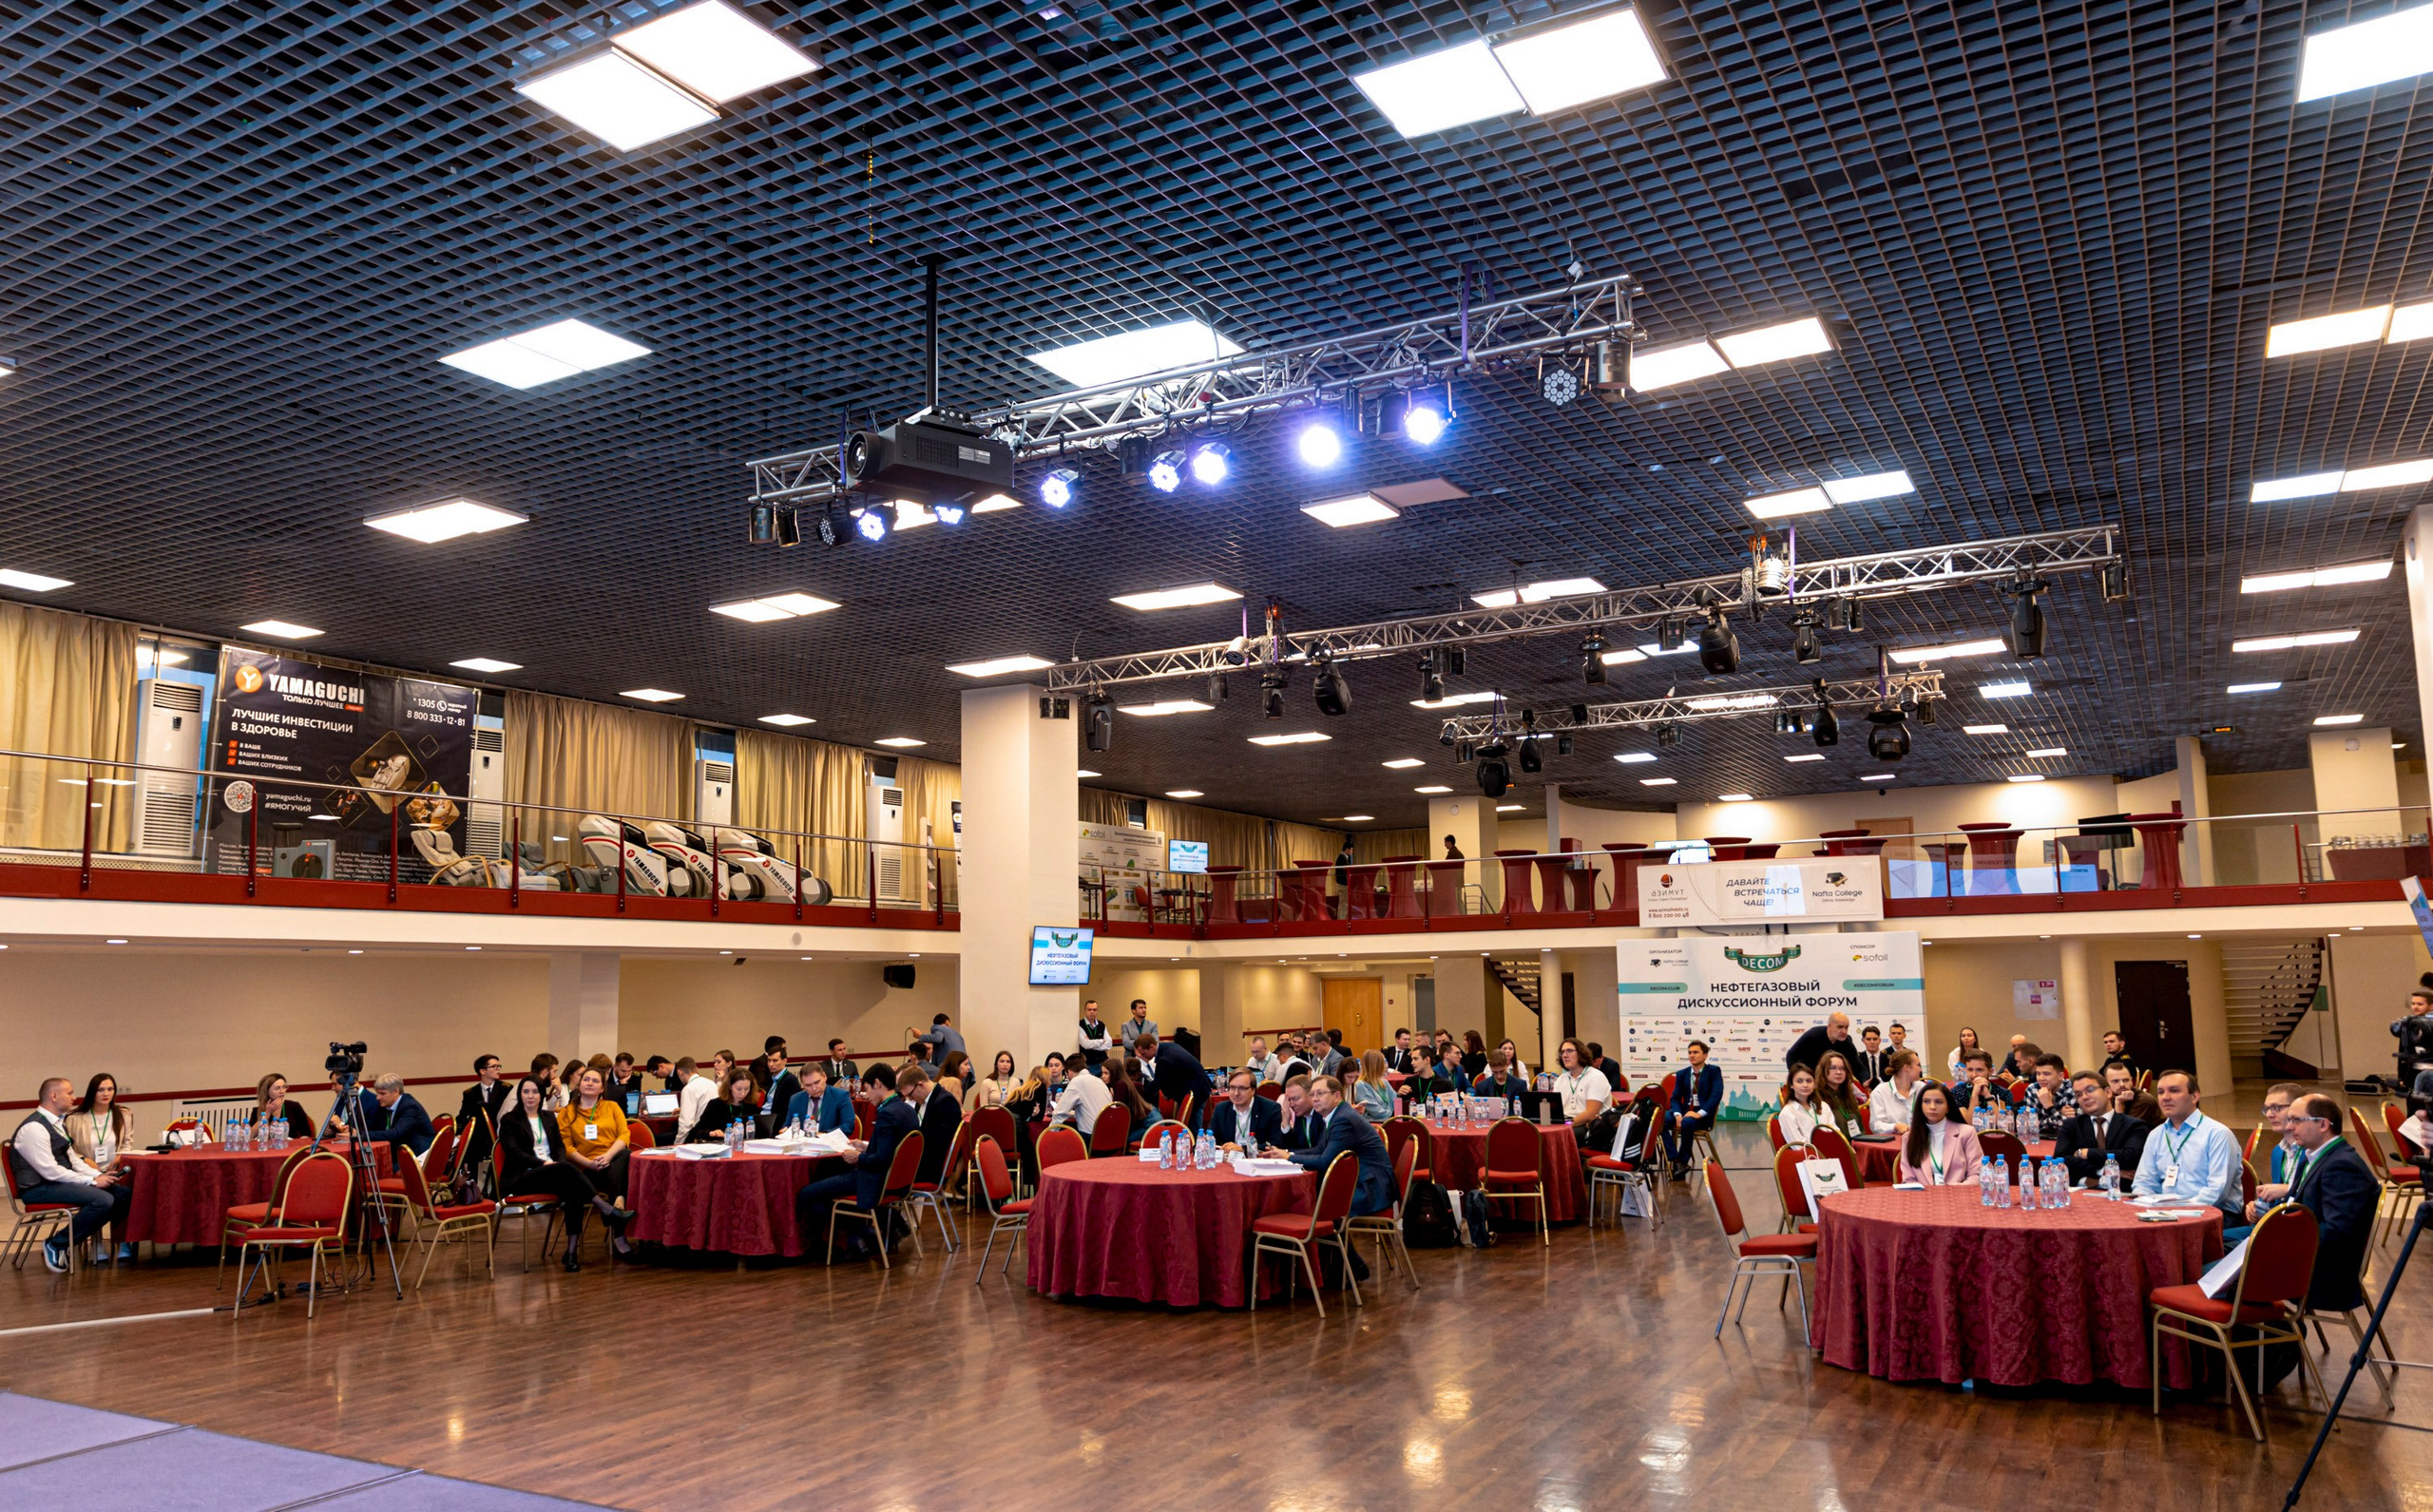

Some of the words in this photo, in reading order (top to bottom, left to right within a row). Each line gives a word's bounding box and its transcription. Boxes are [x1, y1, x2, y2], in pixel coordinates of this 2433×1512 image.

[269, 674, 365, 704] YAMAGUCHI
[282, 695, 313, 705] ТОЛЬКО
[314, 699, 344, 710] ЛУЧШЕЕ
[232, 709, 280, 723] ЛУЧШИЕ
[282, 715, 354, 733] ИНВЕСТИЦИИ
[413, 711, 428, 720] 800
[231, 721, 238, 731] В
[240, 722, 297, 739] ЗДОРОВЬЕ
[261, 753, 288, 762] БЛИЗКИХ
[260, 761, 302, 772] СОТРУДНИКОВ
[265, 793, 311, 803] yamaguchi.ru
[265, 803, 311, 812] #ЯМОГУЧИЙ
[633, 856, 661, 886] YAMAGUCHI
[769, 866, 795, 893] YAMAGUCHI
[1726, 877, 1770, 887] ДАВАЙТЕ
[1734, 887, 1800, 896] ВСТРЕЧАТЬСЯ
[1743, 899, 1773, 907] ЧАЩЕ!
[1742, 957, 1784, 969] DECOM
[1711, 980, 1820, 993] НЕФТЕГАЗОВЫЙ
[1677, 995, 1801, 1009] ДИСКУССИОННЫЙ
[1805, 996, 1857, 1007] ФОРУМ
